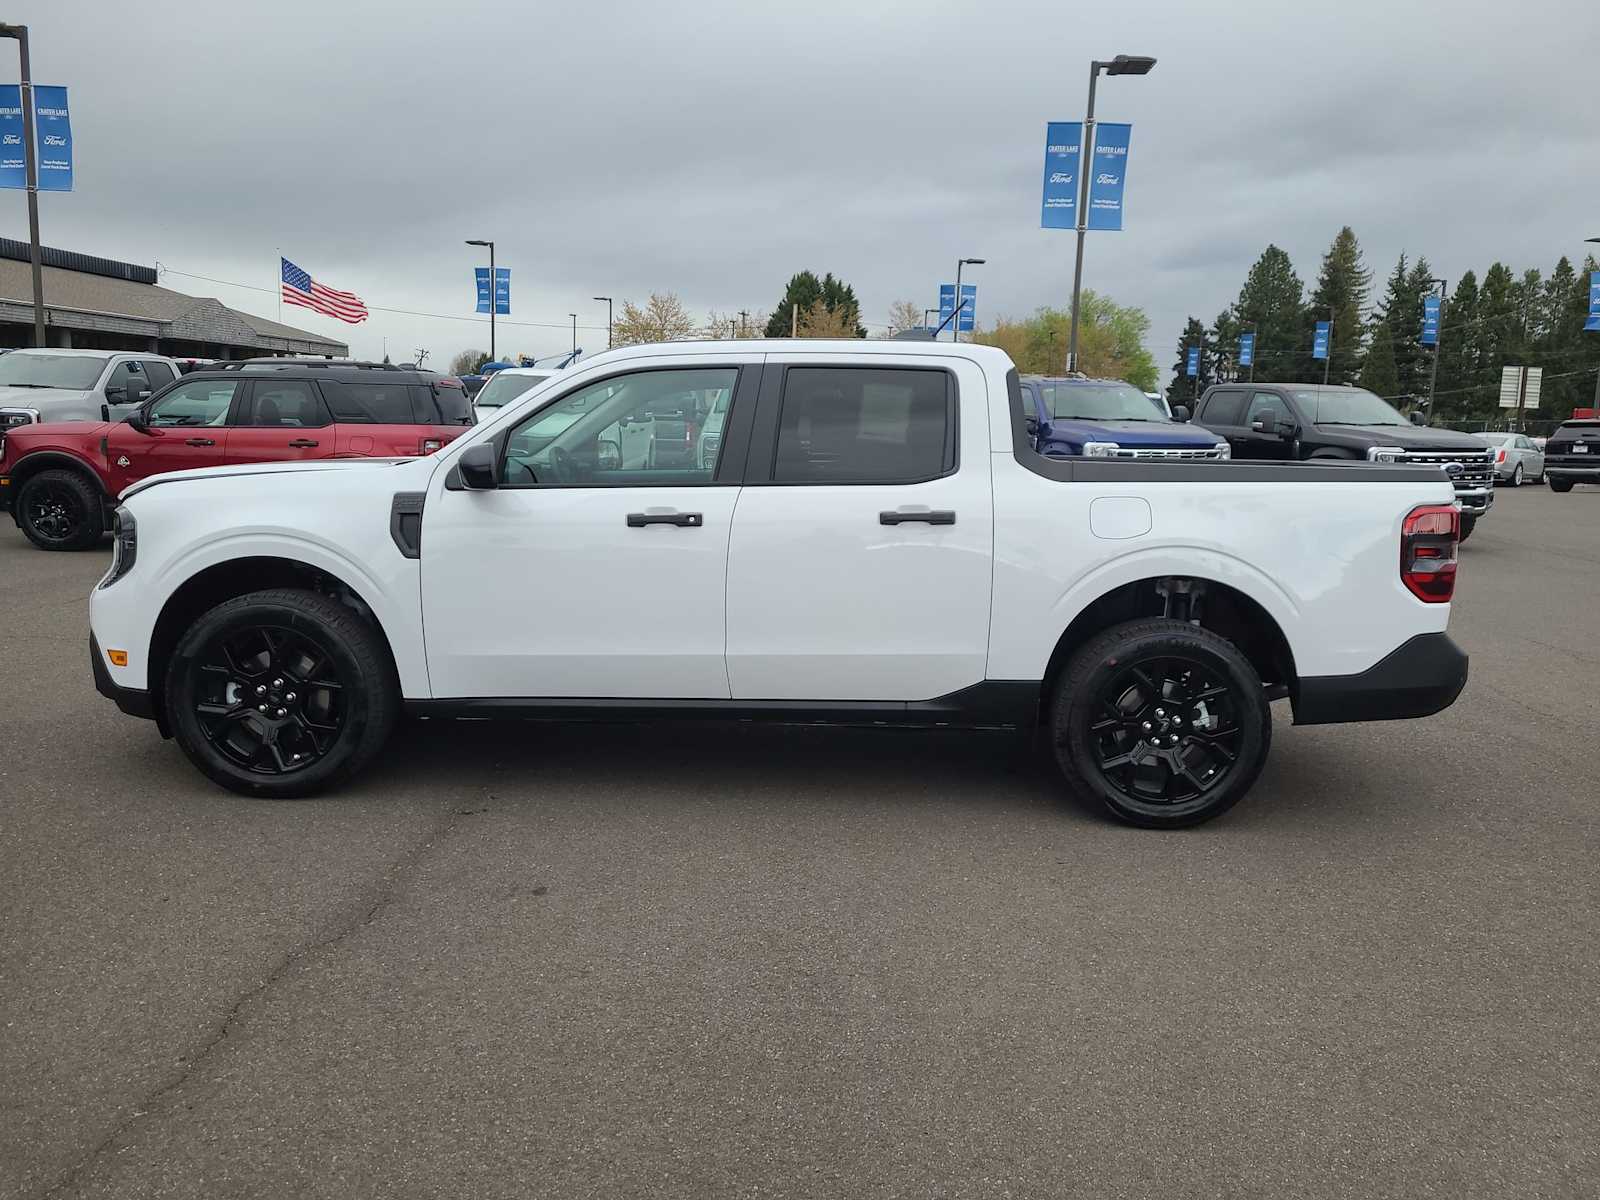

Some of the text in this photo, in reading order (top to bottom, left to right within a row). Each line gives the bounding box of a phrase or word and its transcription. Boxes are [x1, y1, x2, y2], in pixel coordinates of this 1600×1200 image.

[38, 107, 68, 117] CRATER LAKE
[3, 134, 21, 145] Ford
[44, 135, 66, 146] Ford
[1048, 145, 1079, 153] CRATER LAKE
[1096, 146, 1127, 155] CRATER LAKE
[1050, 172, 1073, 184] Ford
[1096, 173, 1120, 185] Ford
